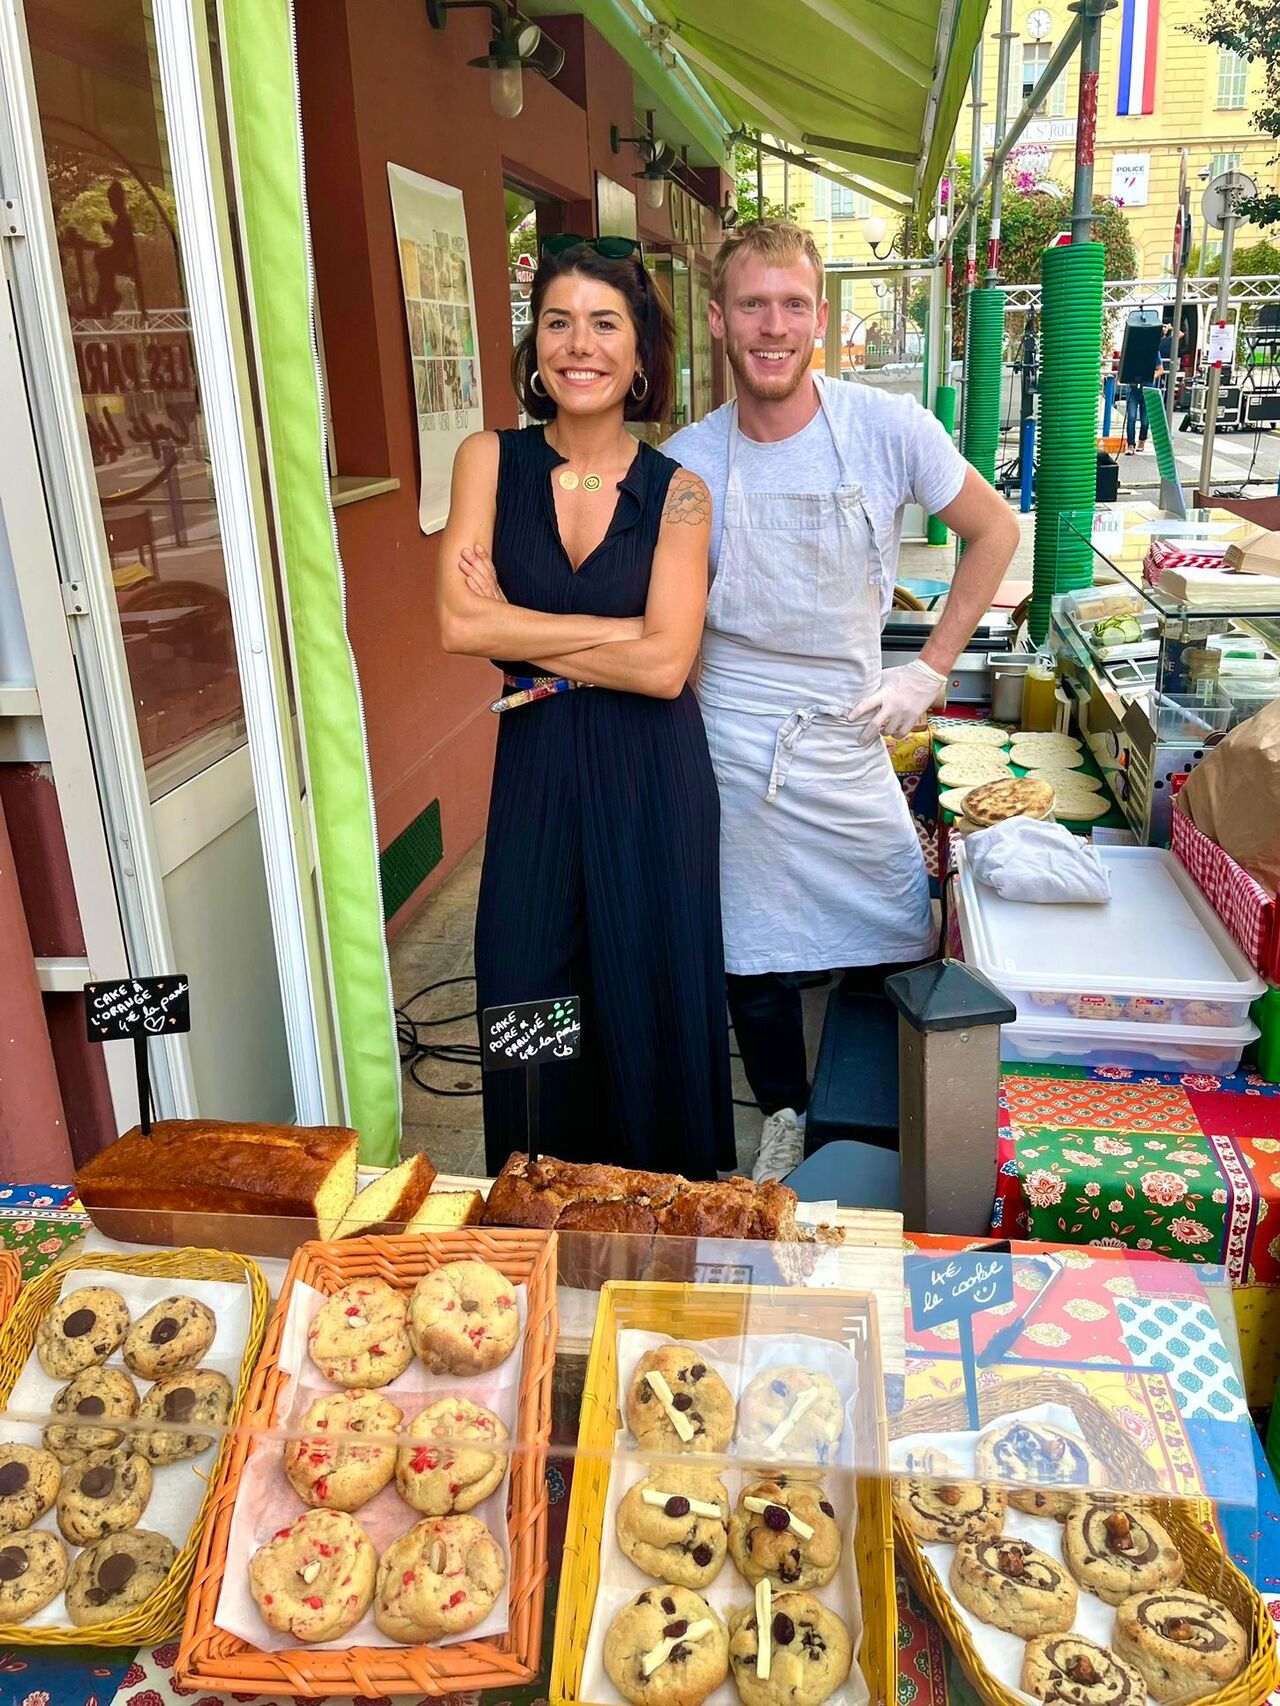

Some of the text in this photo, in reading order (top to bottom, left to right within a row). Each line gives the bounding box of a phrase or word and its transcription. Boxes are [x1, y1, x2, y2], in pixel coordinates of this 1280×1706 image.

[91, 989, 152, 1025] L'ORANGE
[93, 984, 128, 1009] CAKE
[119, 982, 190, 1032] 4€ la part
[490, 1010, 517, 1035] CAKE
[519, 1020, 581, 1060] 4€ la part
[923, 1261, 1004, 1313] le cookie
[931, 1261, 961, 1286] 4€
